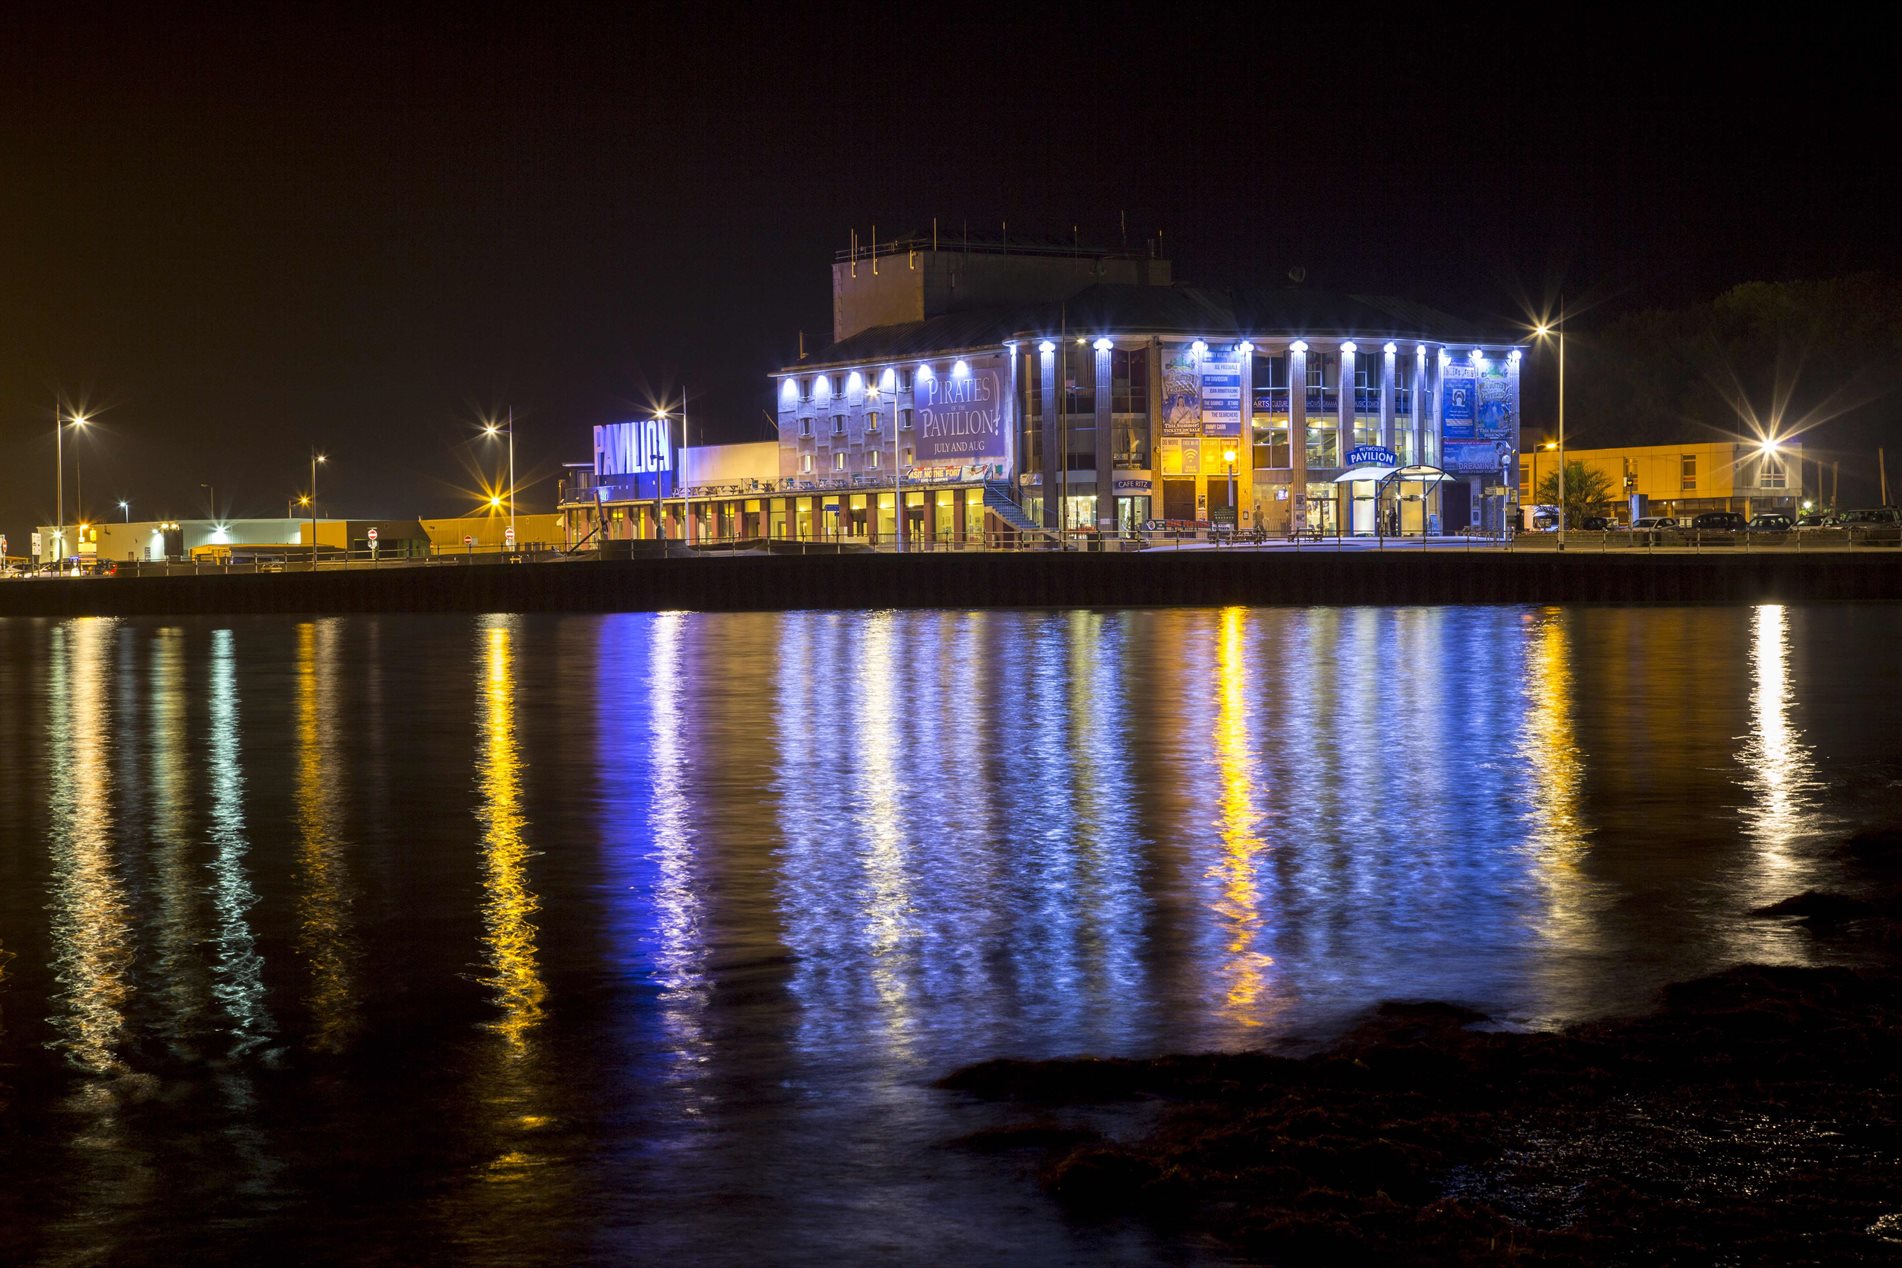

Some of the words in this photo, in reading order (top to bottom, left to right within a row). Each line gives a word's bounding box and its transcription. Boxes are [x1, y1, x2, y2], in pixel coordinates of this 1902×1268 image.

[926, 376, 991, 406] PIRATES
[1253, 400, 1270, 408] ARTS
[593, 419, 672, 475] PAVILION
[934, 443, 950, 455] JULY
[950, 441, 968, 452] AND
[969, 440, 985, 451] AUG
[1351, 451, 1393, 463] PAVILION
[1118, 480, 1134, 488] CAFE
[1135, 480, 1148, 488] RITZ
